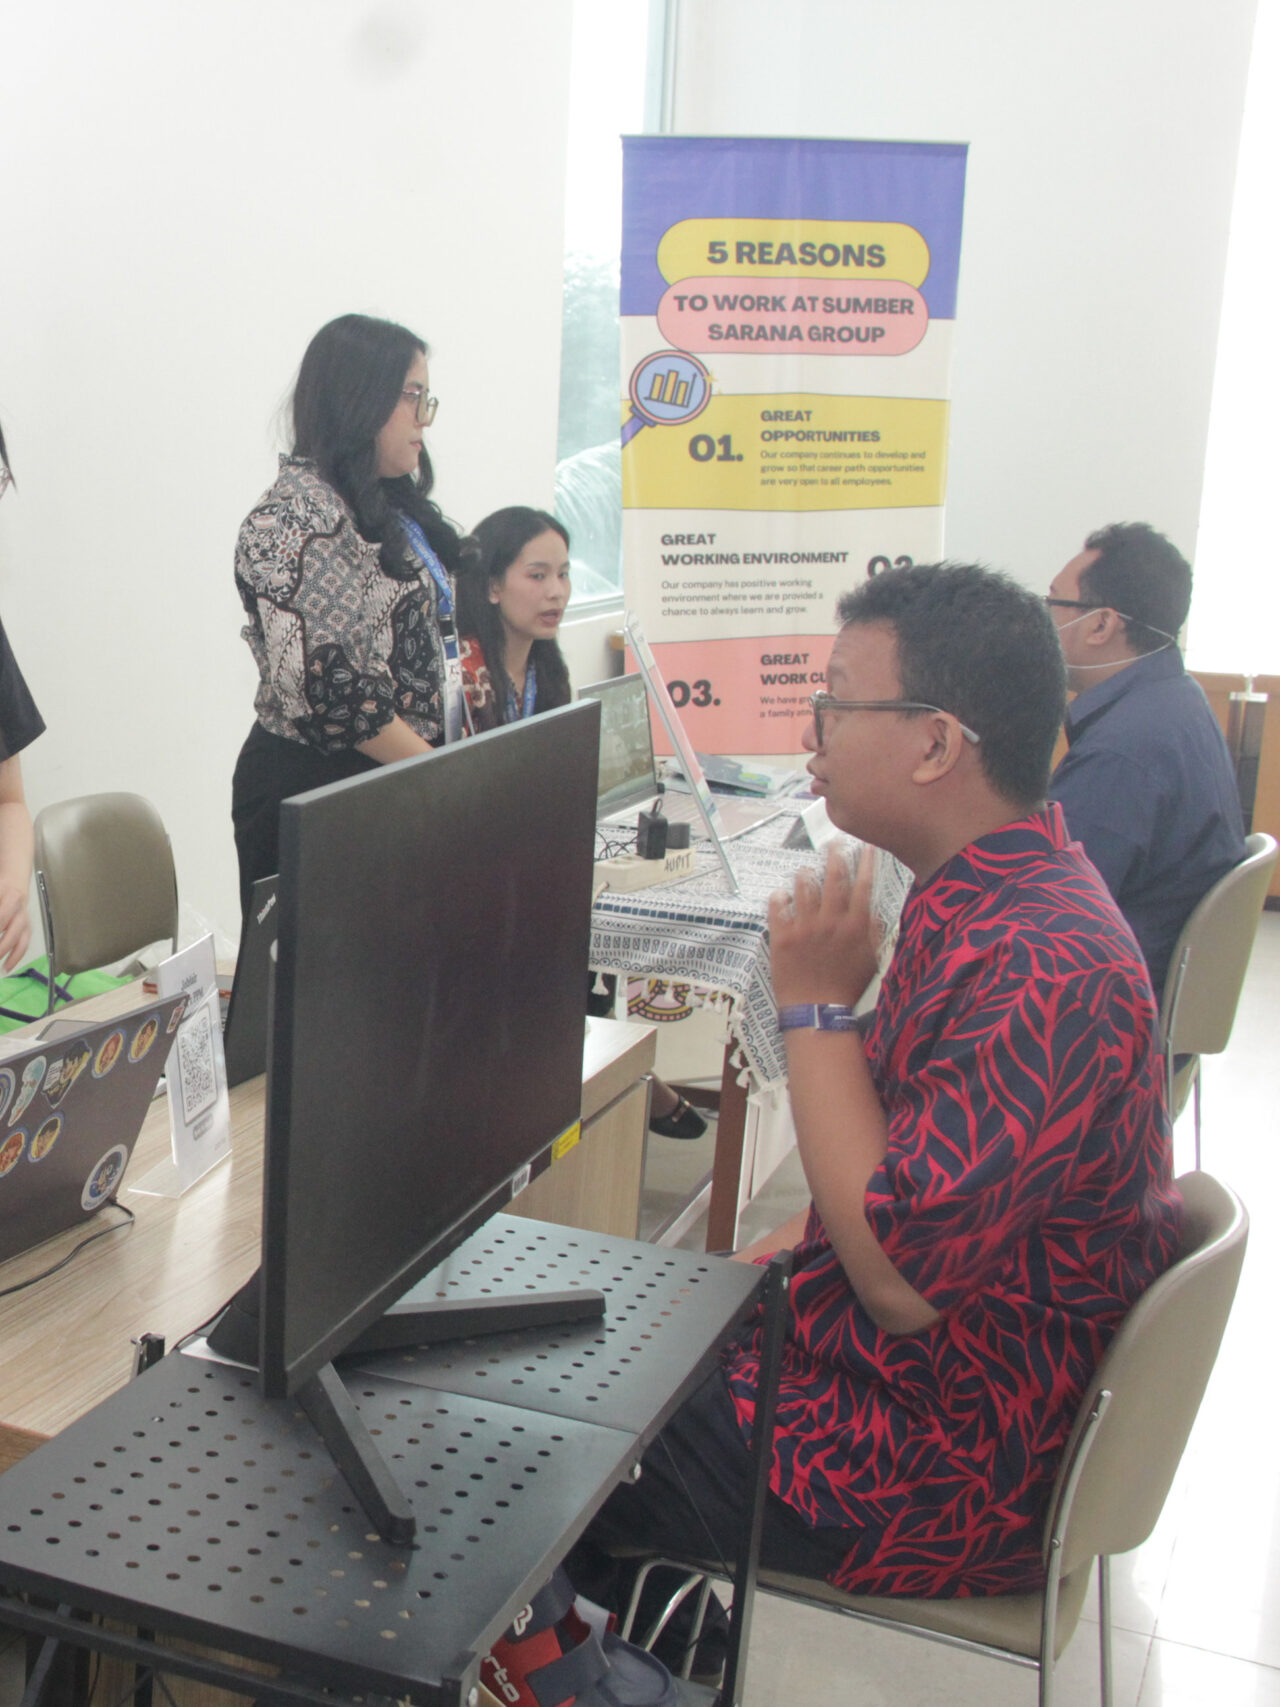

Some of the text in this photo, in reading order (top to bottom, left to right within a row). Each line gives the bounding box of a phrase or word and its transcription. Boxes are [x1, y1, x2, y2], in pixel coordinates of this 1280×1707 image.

[707, 240, 886, 268] 5 REASONS
[673, 294, 914, 315] TO WORK AT SUMBER
[708, 324, 885, 343] SARANA GROUP
[761, 410, 812, 423] GREAT
[760, 429, 880, 443] OPPORTUNITIES
[689, 433, 743, 462] 01.
[661, 533, 716, 547] GREAT
[661, 551, 848, 566] WORKING ENVIRONMENT
[760, 652, 809, 666] GREAT
[760, 673, 808, 686] WORK
[667, 679, 722, 709] 03.
